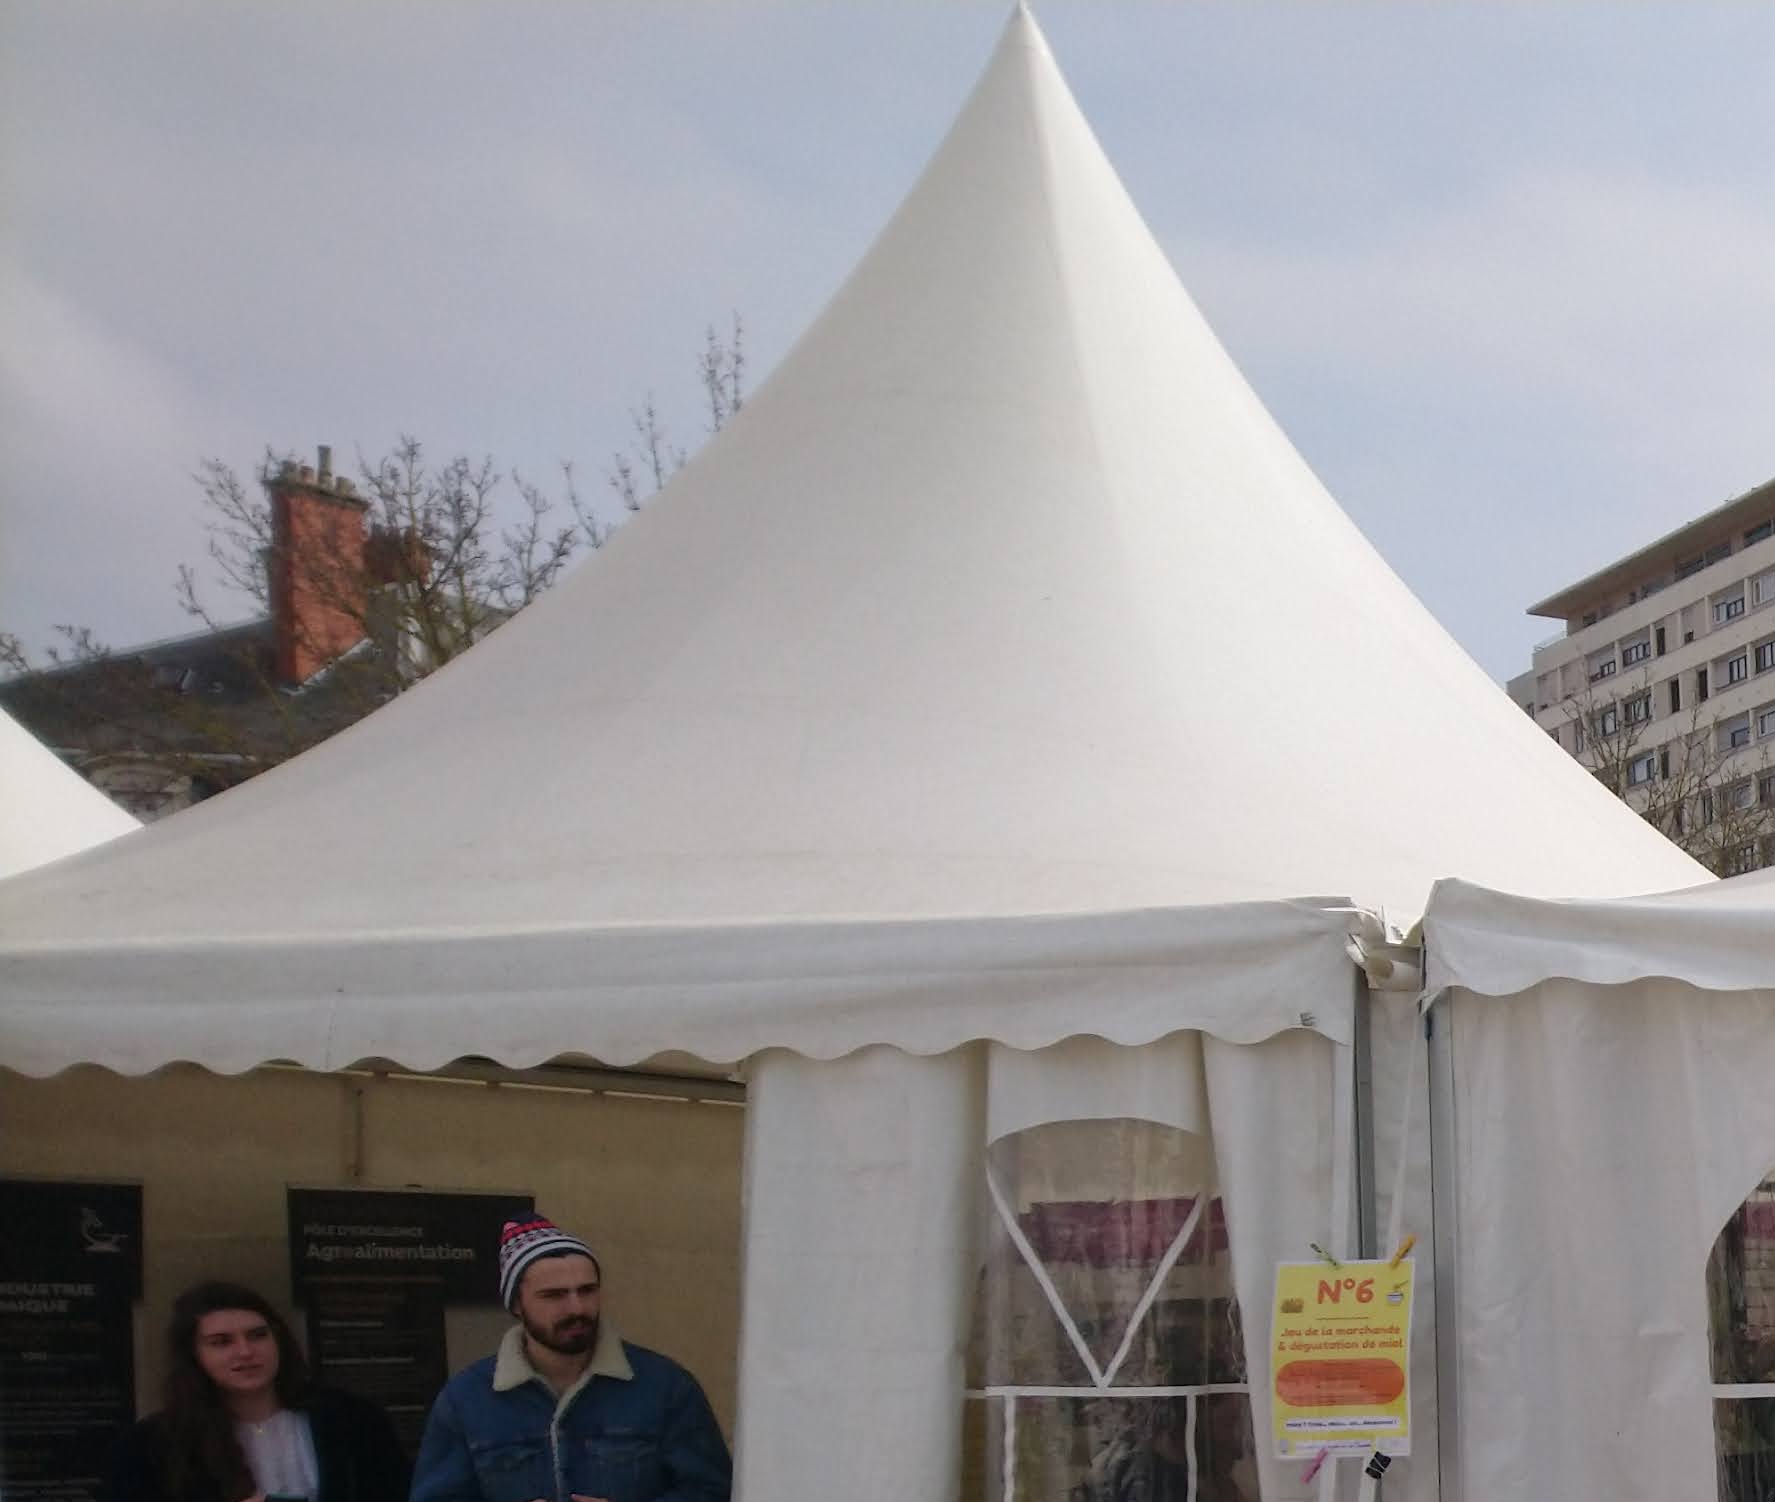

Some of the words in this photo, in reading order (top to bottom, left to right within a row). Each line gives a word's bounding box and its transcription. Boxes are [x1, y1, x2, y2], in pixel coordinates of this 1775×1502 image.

[1317, 1278, 1375, 1304] N°6
[1281, 1327, 1301, 1337] Jeu
[1304, 1327, 1318, 1337] de
[1362, 1339, 1376, 1349] de
[1379, 1338, 1402, 1349] miel
